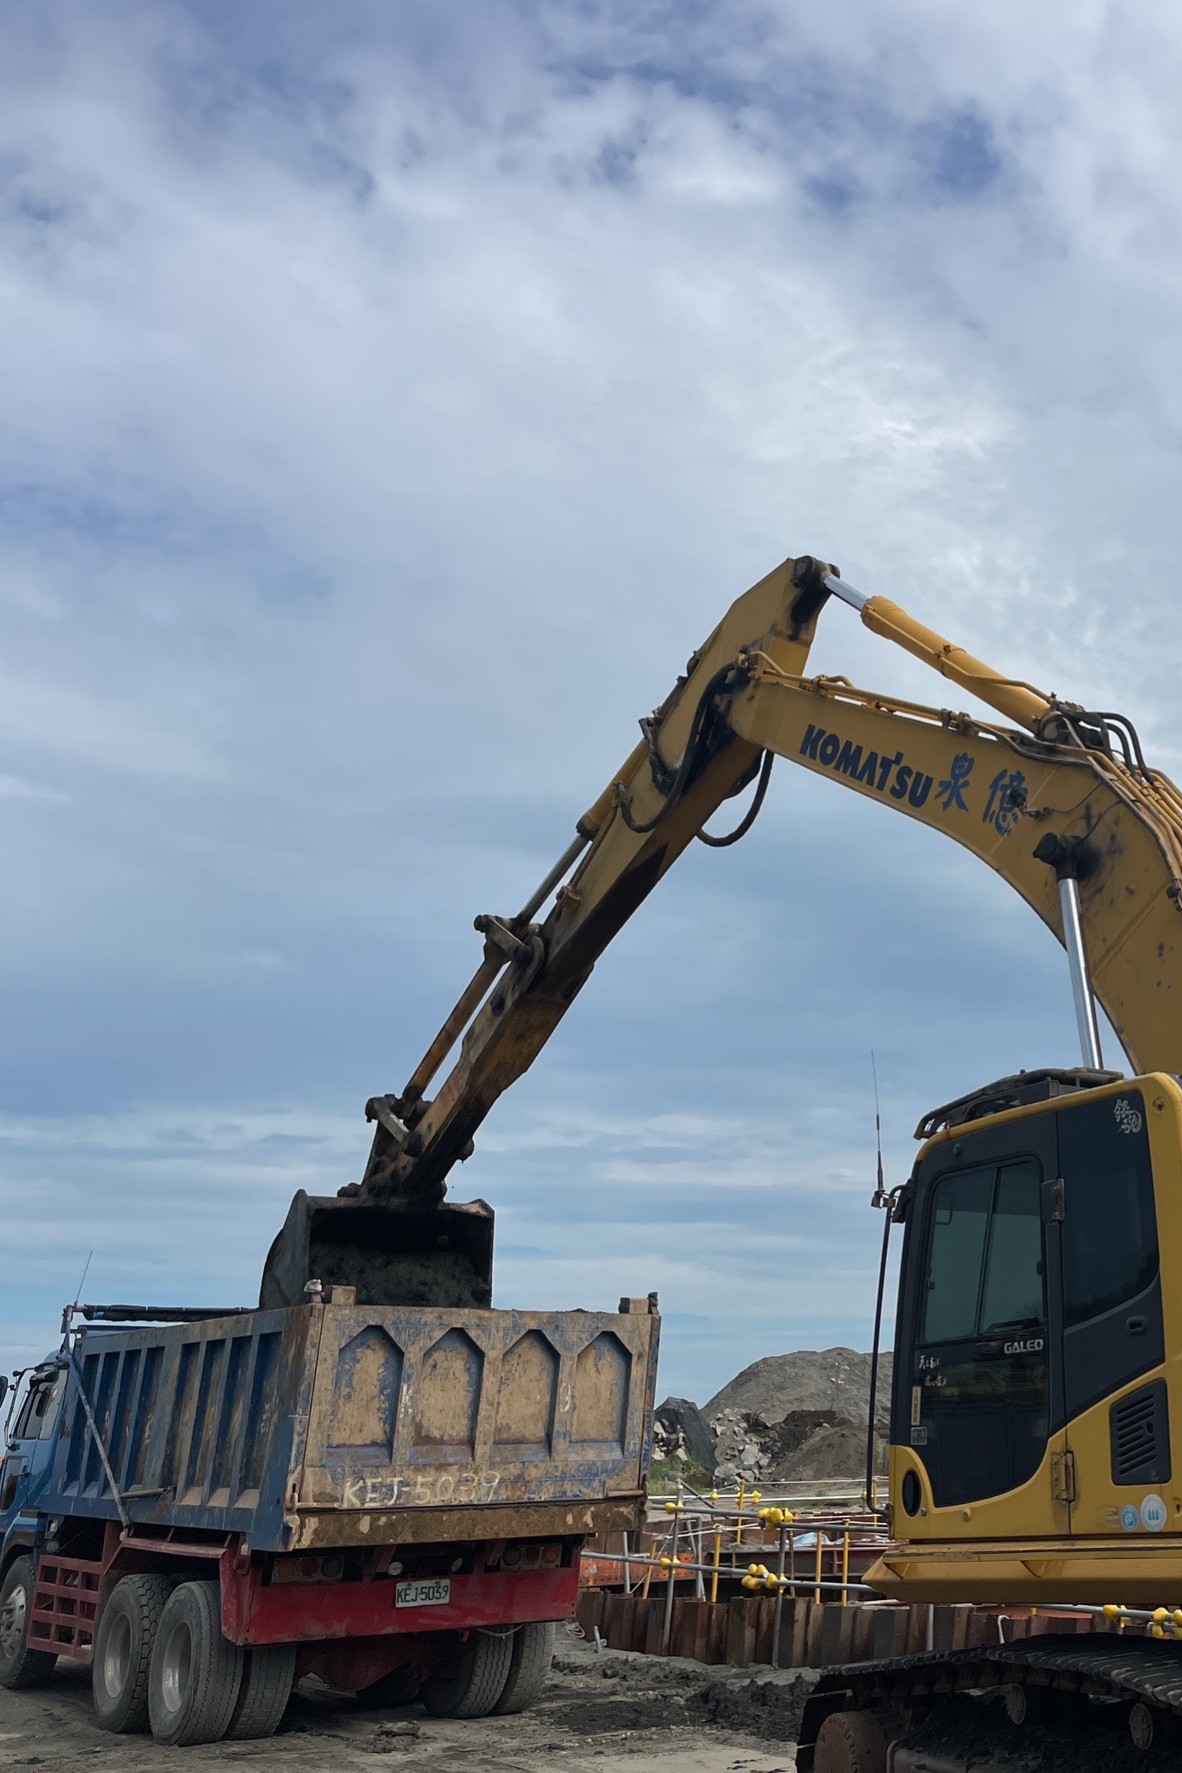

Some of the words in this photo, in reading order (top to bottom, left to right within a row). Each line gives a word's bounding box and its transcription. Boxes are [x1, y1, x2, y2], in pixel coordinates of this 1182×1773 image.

[799, 724, 933, 808] KOMATSU
[1003, 1338, 1044, 1354] GALEO
[342, 1470, 501, 1508] KEJ-5039
[396, 1584, 450, 1604] KEJ-5039
